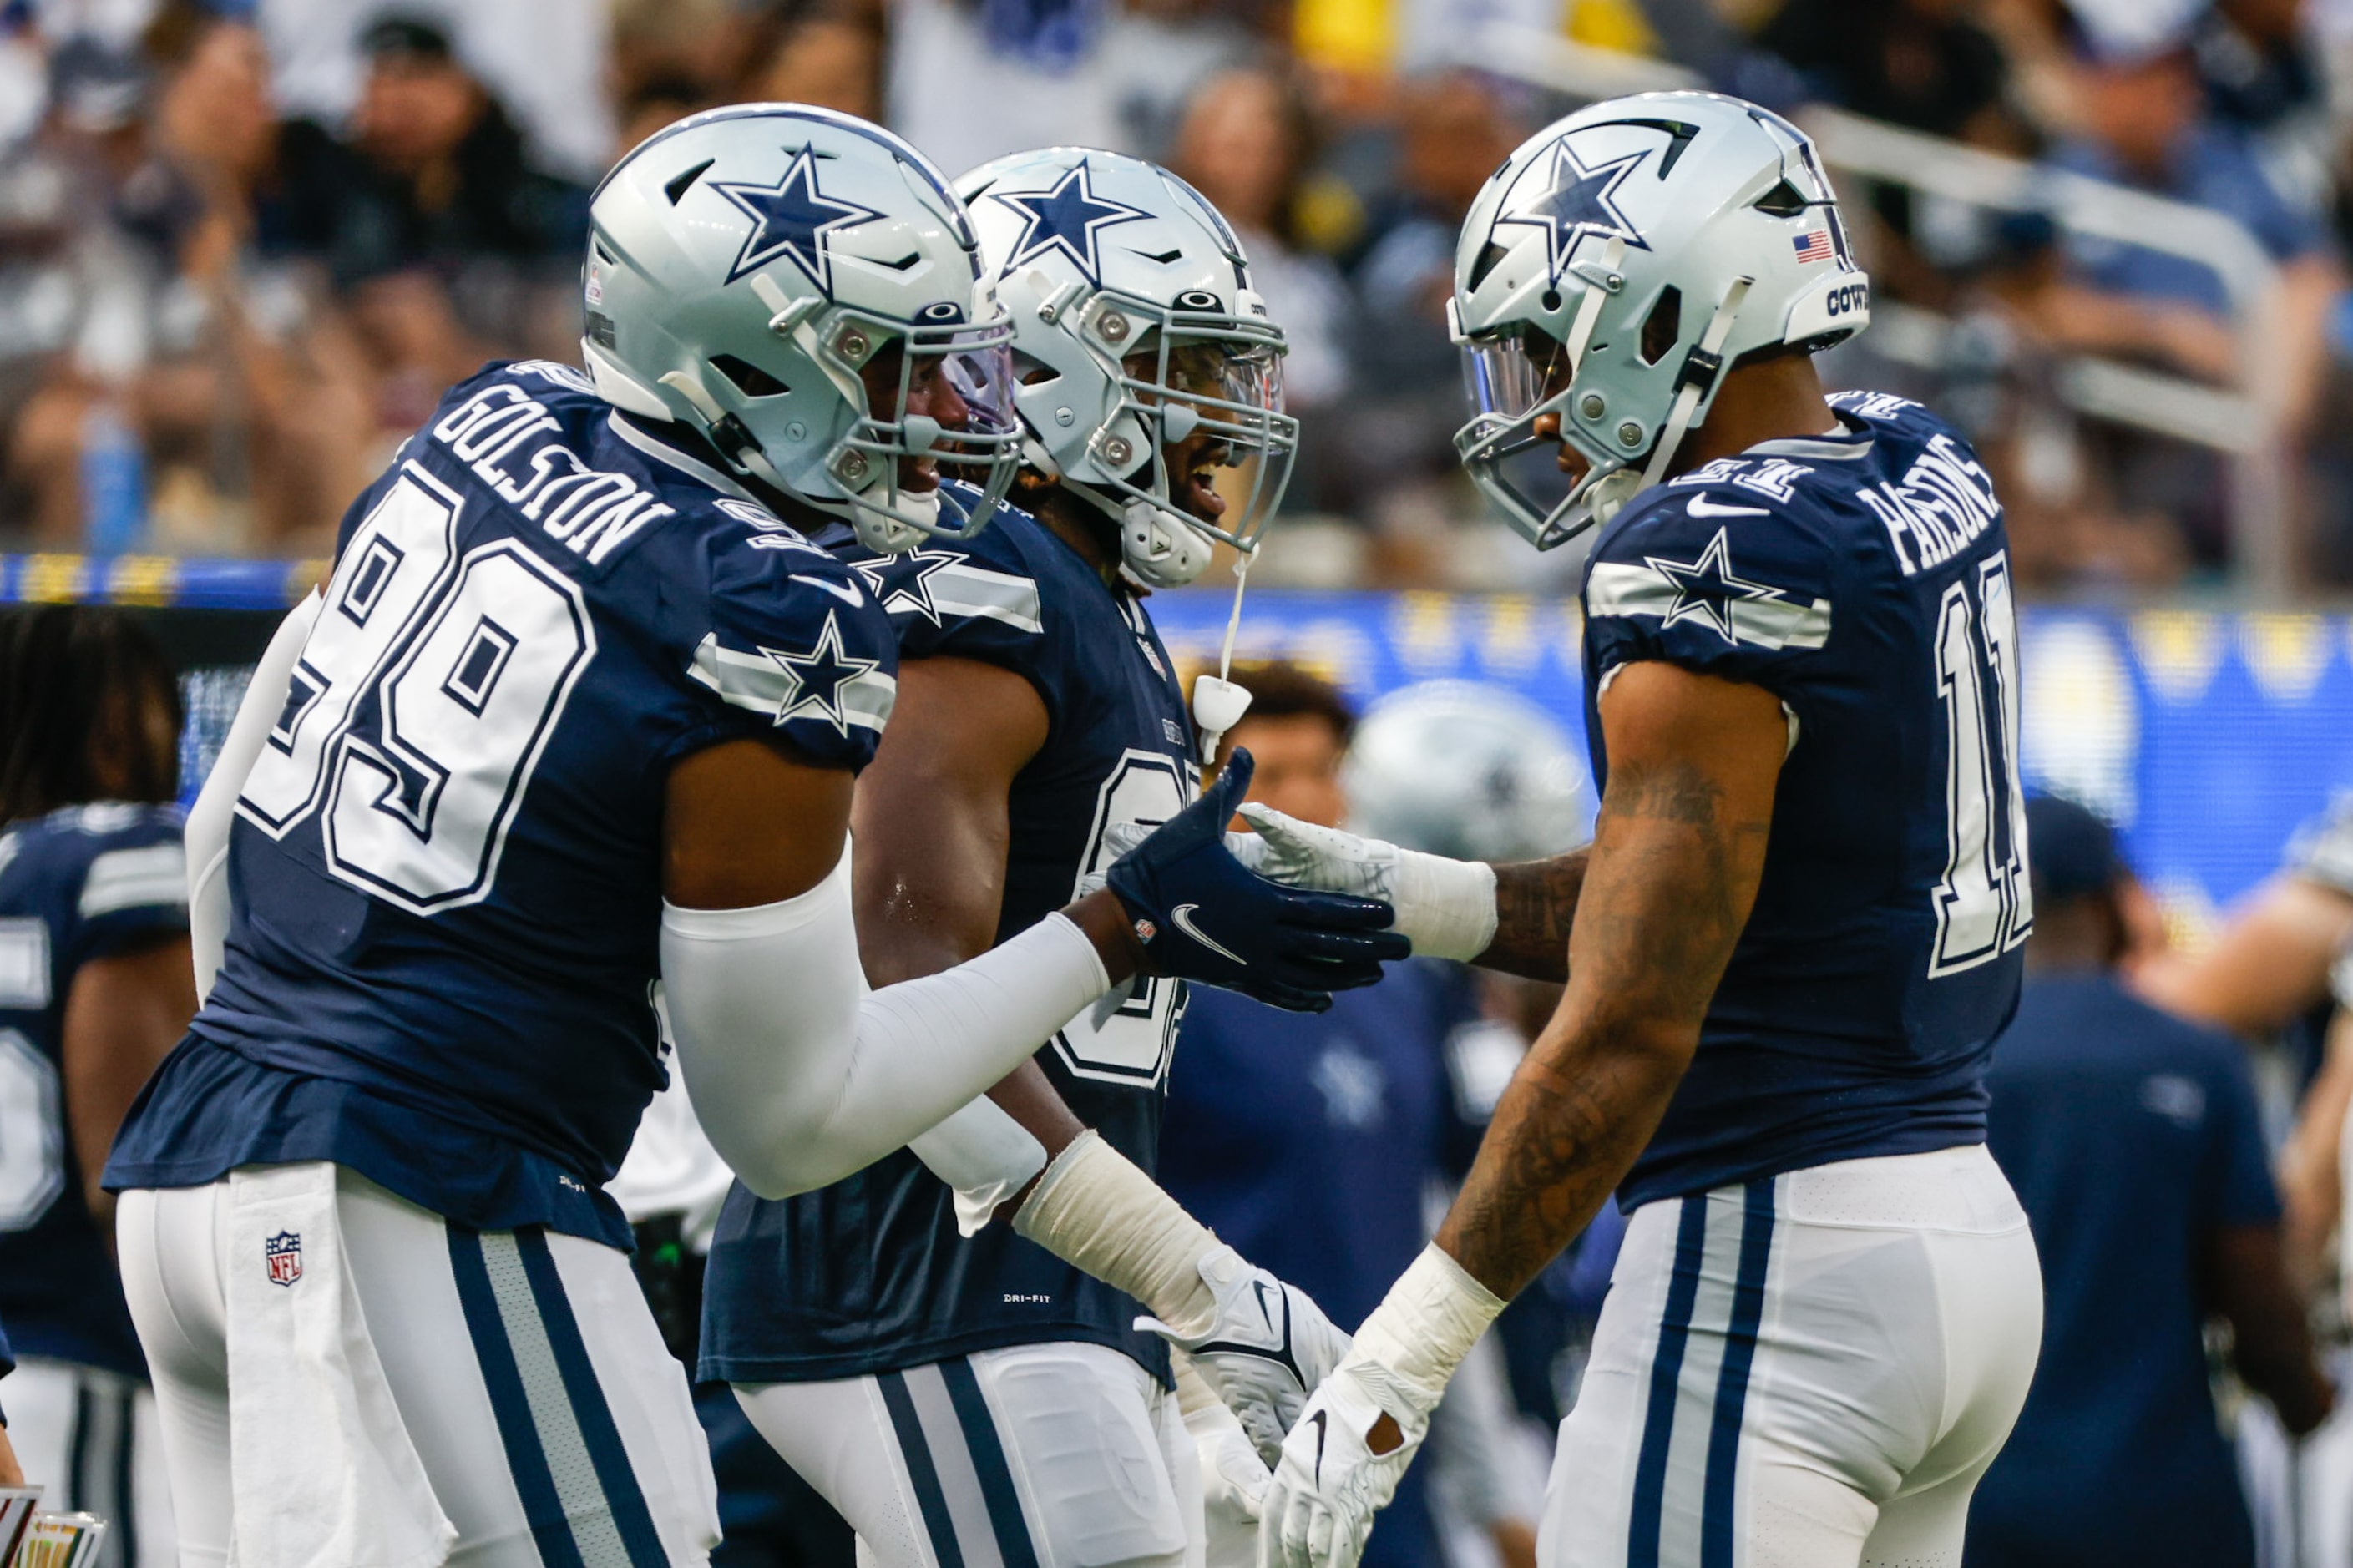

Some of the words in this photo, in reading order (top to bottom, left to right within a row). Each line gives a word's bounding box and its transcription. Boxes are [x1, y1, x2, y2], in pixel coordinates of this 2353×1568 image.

[234, 458, 597, 917] 99
[1927, 549, 2033, 980] 11
[268, 1254, 300, 1282] NFL
[1004, 1293, 1051, 1303] DRI-FIT
